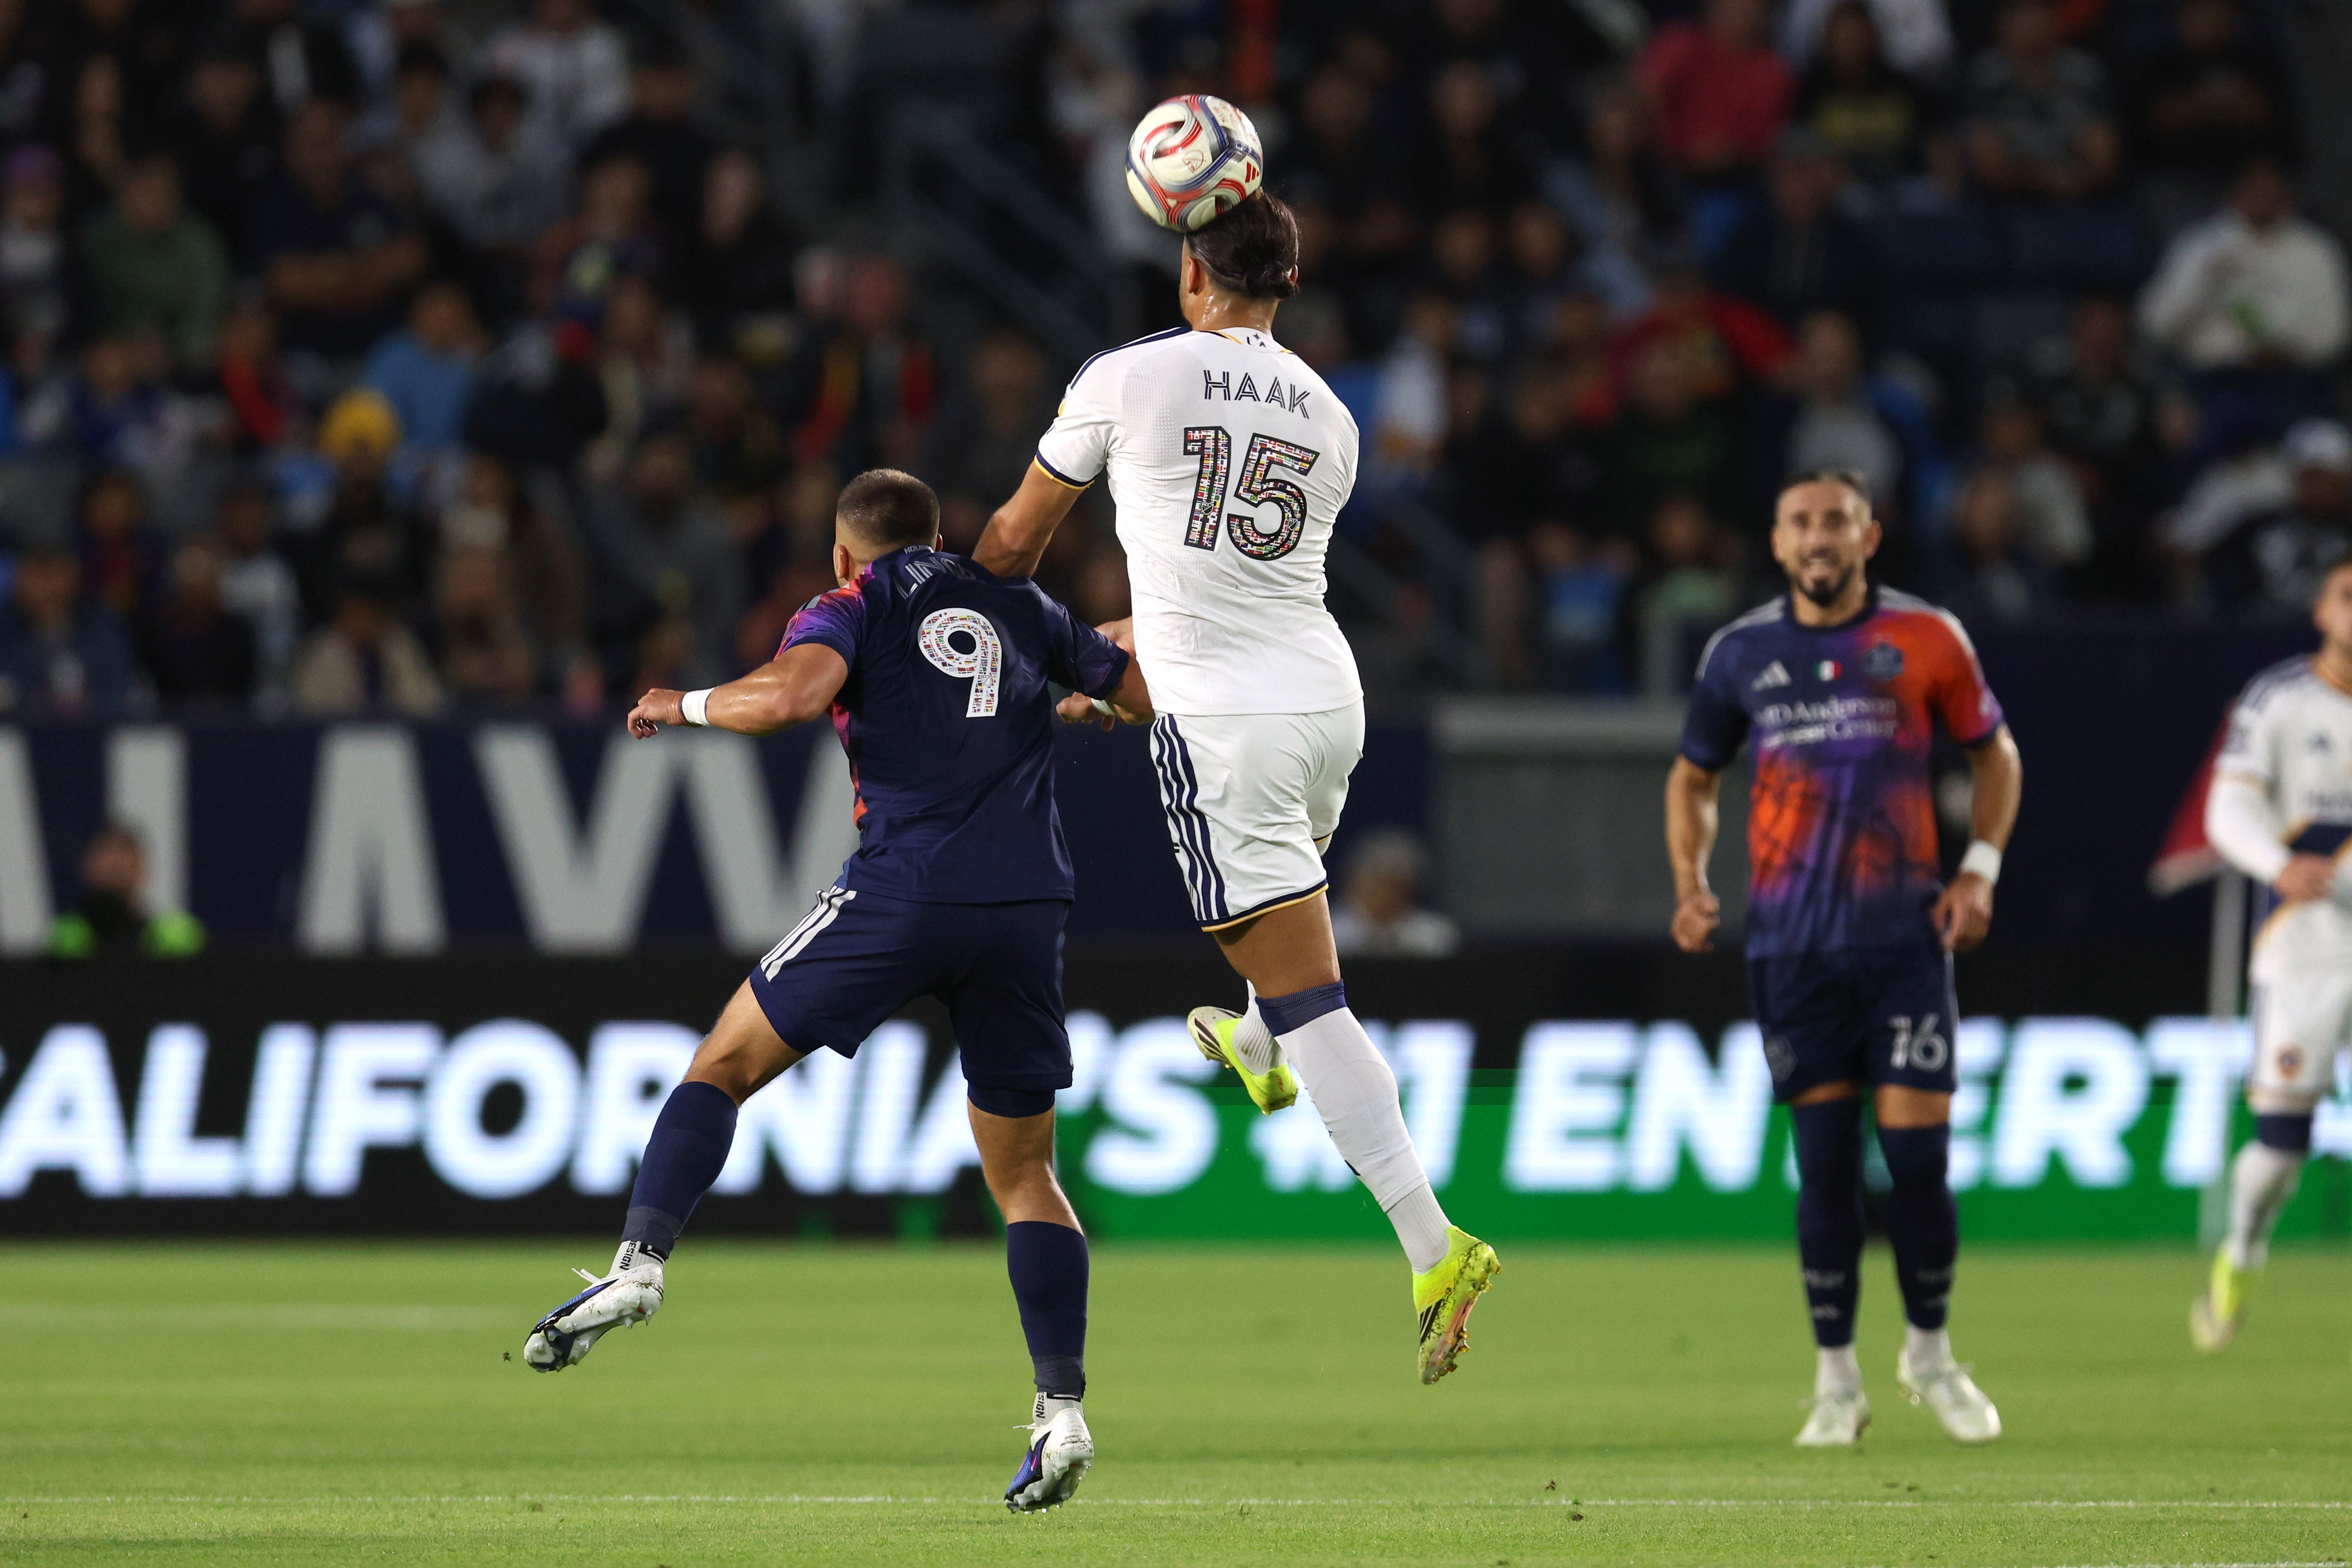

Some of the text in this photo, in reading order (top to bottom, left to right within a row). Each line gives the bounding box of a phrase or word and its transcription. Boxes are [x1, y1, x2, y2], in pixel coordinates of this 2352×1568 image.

[1203, 369, 1311, 419] HAAK
[1184, 426, 1321, 561] 15
[918, 607, 1003, 718] 9
[1889, 1013, 1948, 1072] 16
[0, 1016, 1218, 1198] ALIFORNIA'S
[619, 1240, 637, 1271] ESIGN
[1035, 1391, 1046, 1418] SIGN
